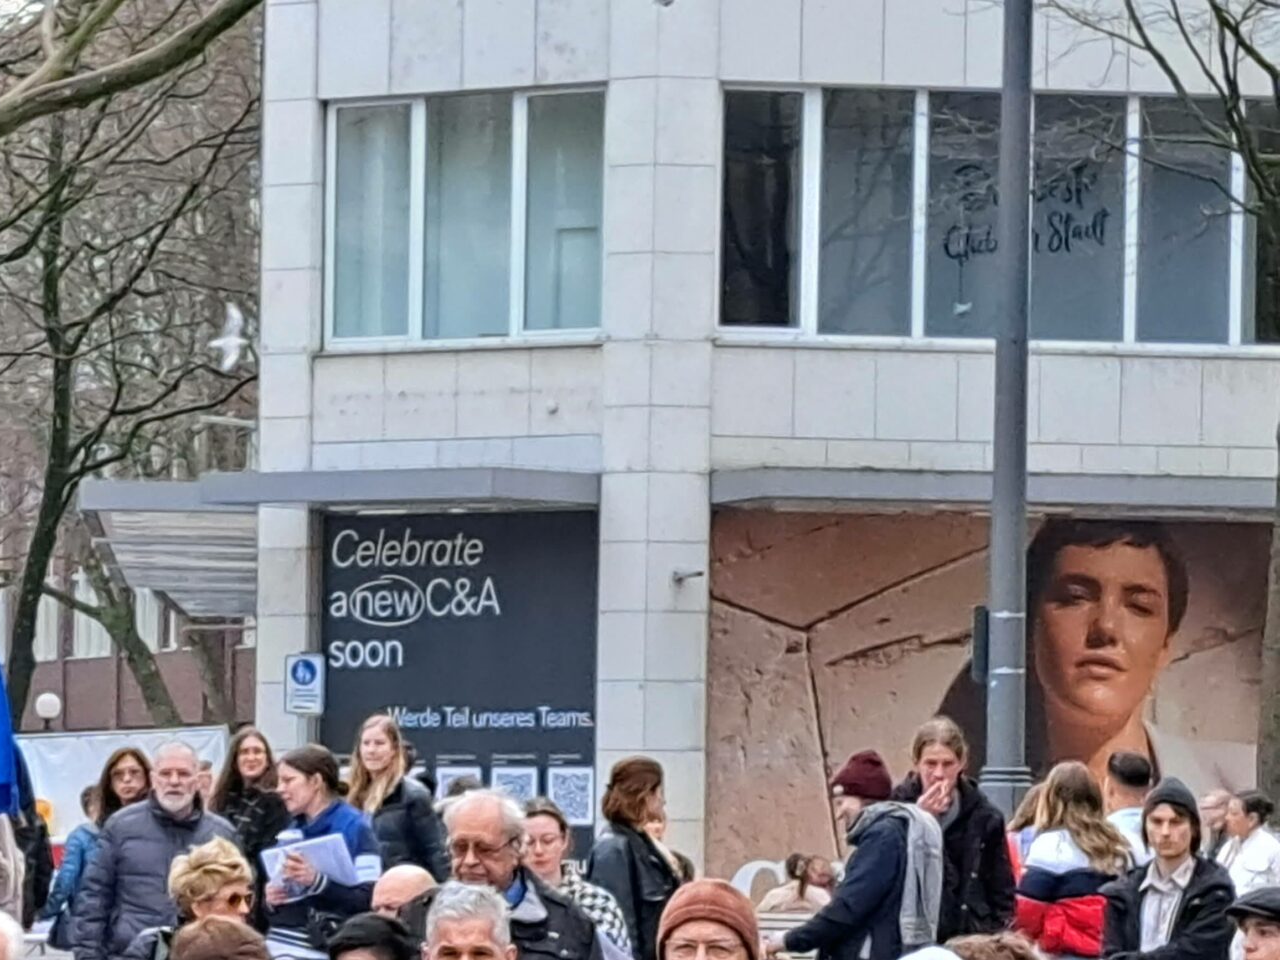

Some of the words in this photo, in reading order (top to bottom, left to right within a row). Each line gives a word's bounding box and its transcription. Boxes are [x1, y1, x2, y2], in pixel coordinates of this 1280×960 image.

[331, 527, 484, 568] Celebrate
[329, 590, 348, 618] a
[355, 590, 421, 617] new
[426, 576, 501, 617] C&A
[328, 639, 403, 668] soon
[387, 706, 442, 727] Werde
[443, 707, 470, 727] Teil
[472, 710, 535, 727] unseres
